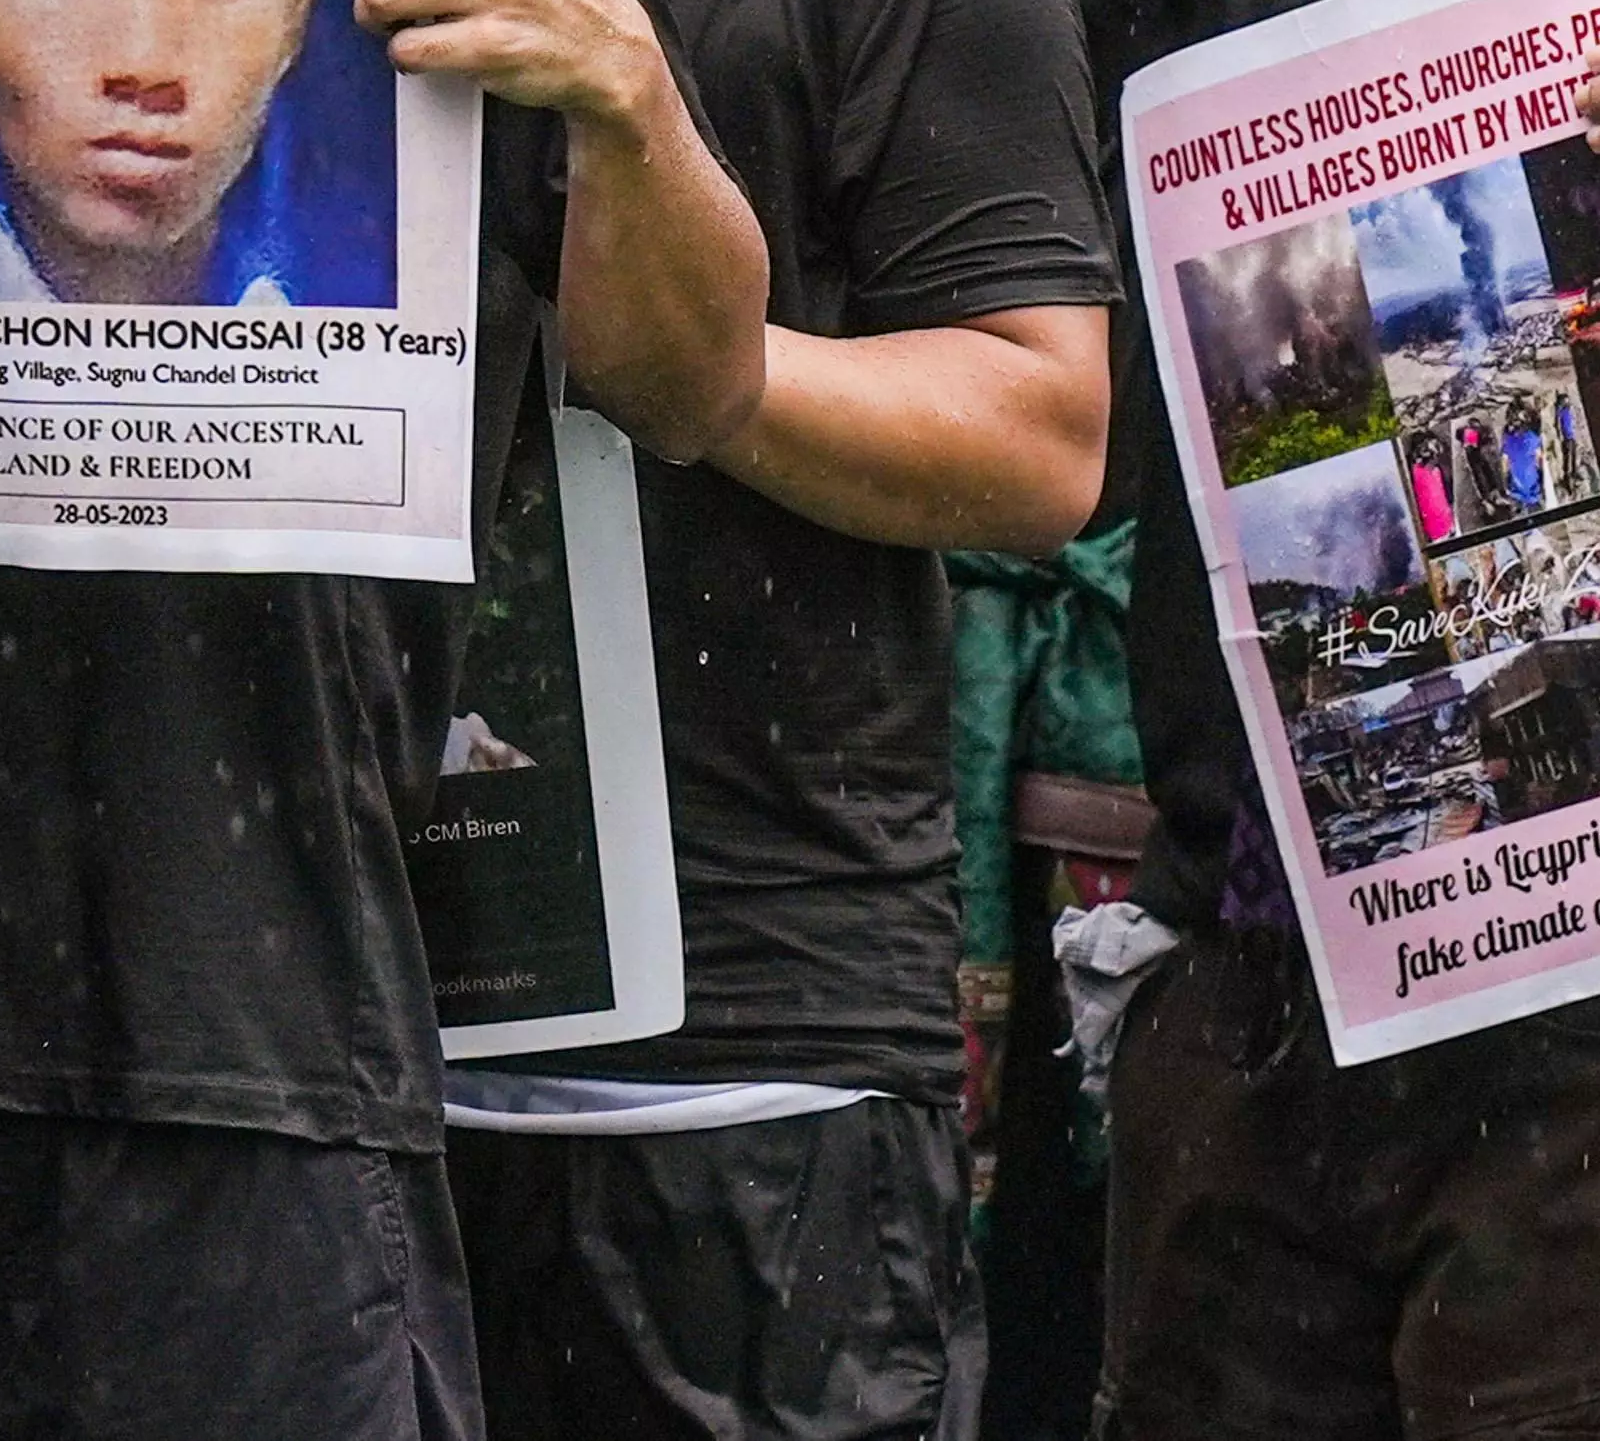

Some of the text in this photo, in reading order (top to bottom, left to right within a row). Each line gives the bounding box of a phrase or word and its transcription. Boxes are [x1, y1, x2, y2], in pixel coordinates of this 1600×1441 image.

[1149, 108, 1304, 194] COUNTLESS
[1305, 72, 1422, 143] HOUSES,
[1420, 22, 1573, 104] CHURCHES,
[1221, 188, 1248, 230] &
[1244, 146, 1375, 223] VILLAGES
[1378, 113, 1468, 181] BURNT
[1474, 100, 1510, 150] BY
[105, 319, 303, 351] KHONGSAI
[317, 321, 366, 358] (38
[376, 323, 466, 366] Years)
[87, 363, 146, 387] Sugnu
[153, 364, 236, 384] Chandel
[243, 365, 319, 384] District
[63, 418, 103, 441] OF
[111, 419, 177, 443] OUR
[184, 421, 364, 446] ANCESTRAL
[80, 455, 101, 478] &
[110, 456, 251, 480] FREEDOM
[53, 504, 168, 526] 28-05-2023
[425, 822, 460, 843] CM
[466, 819, 521, 839] Biren
[1350, 872, 1458, 926] Where
[1463, 857, 1492, 895] is
[1395, 936, 1466, 998] fake
[1473, 900, 1587, 961] climate
[433, 969, 537, 996] ookmarks
